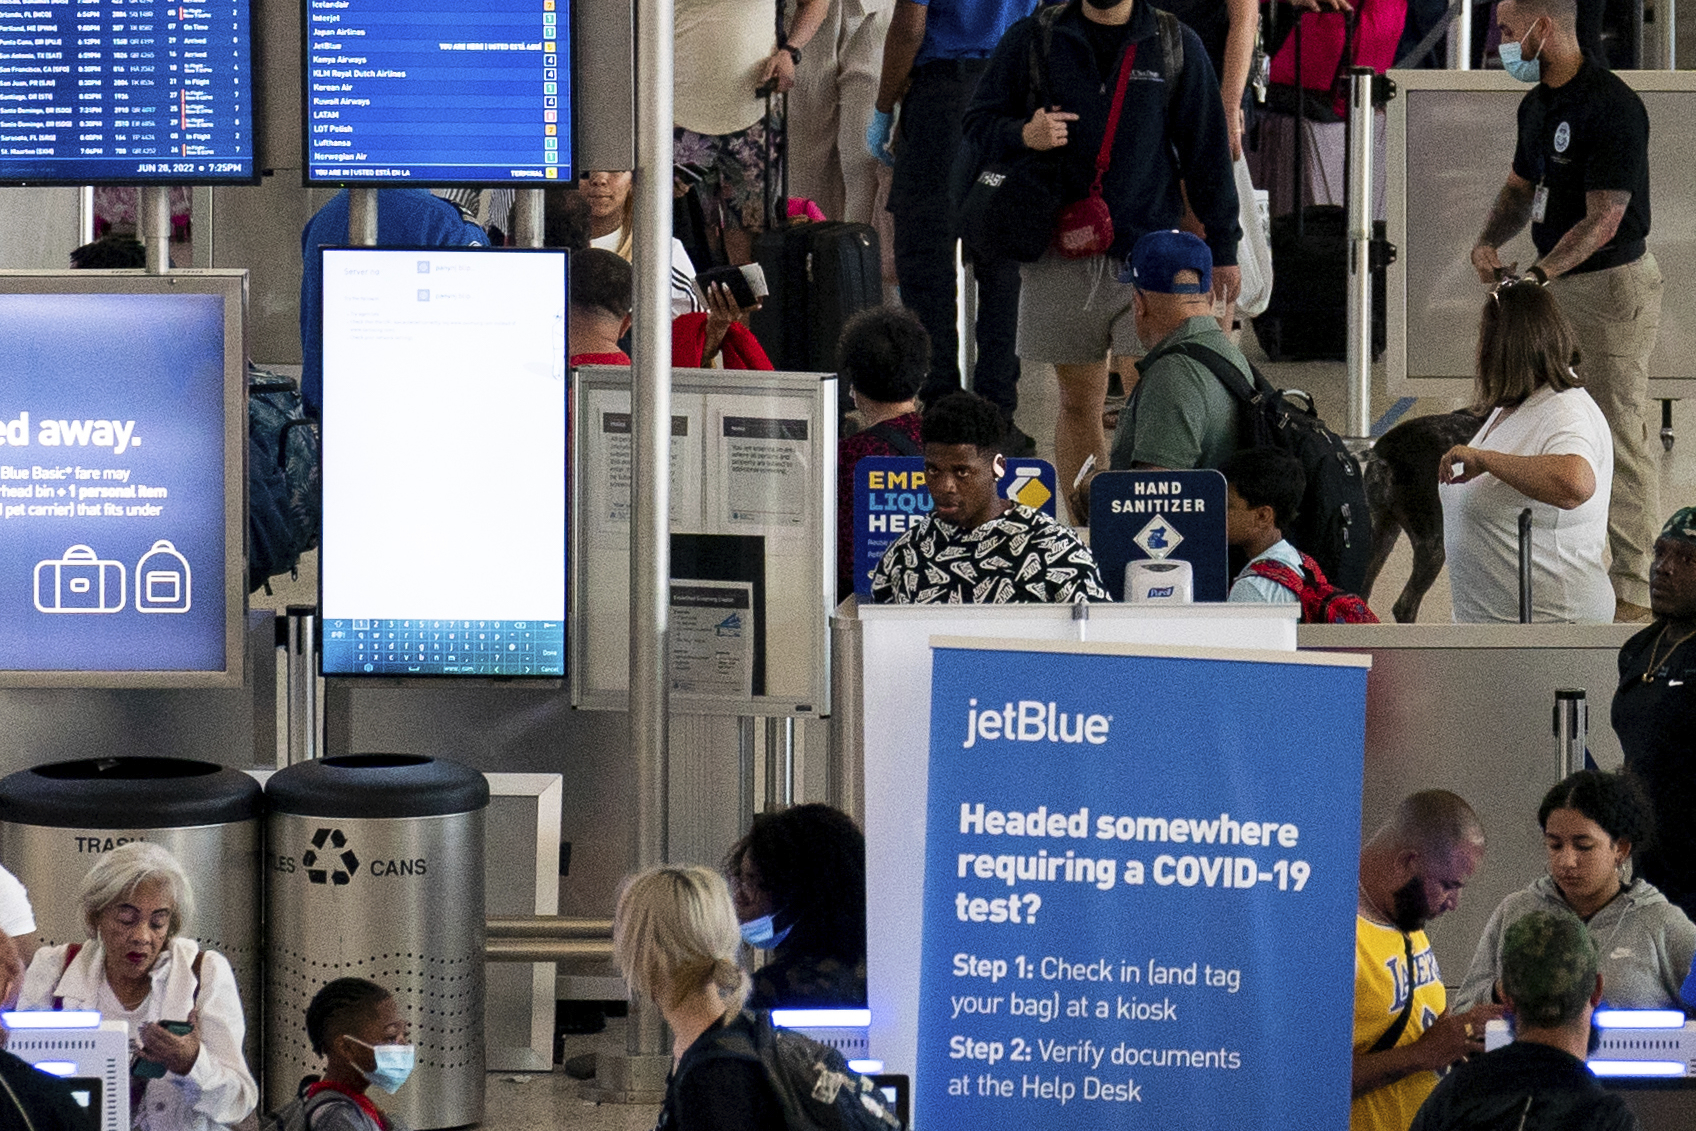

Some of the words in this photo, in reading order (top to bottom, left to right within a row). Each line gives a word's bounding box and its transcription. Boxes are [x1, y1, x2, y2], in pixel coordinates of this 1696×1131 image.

[313, 15, 340, 23] Interjet
[337, 56, 367, 64] Airways
[332, 70, 352, 78] Royal
[354, 69, 375, 77] Dutch
[340, 98, 370, 106] Airways
[315, 153, 354, 161] Norwegian
[137, 164, 156, 172] JUN
[174, 164, 194, 172] 2022
[209, 163, 241, 171] 7:25PM
[38, 419, 141, 454] away.
[75, 466, 101, 479] fare
[103, 469, 130, 483] may
[869, 472, 926, 489] EMP
[0, 484, 32, 497] head
[35, 484, 54, 497] bin
[79, 485, 136, 501] personal
[138, 485, 168, 498] item
[1135, 482, 1181, 494] HAND
[5, 503, 26, 519] pet
[28, 502, 74, 517] carrier)
[77, 503, 101, 516] that
[104, 503, 124, 516] fits
[126, 503, 163, 516] under
[869, 493, 934, 513] LIQU
[1112, 499, 1204, 513] SANITIZER
[869, 515, 924, 532] HE
[963, 699, 1112, 748] jetBlue
[960, 803, 1088, 838] Headed
[1096, 814, 1298, 847] somewhere
[75, 837, 144, 853] TRA
[370, 859, 427, 876] CANS
[958, 850, 1116, 890] requiring
[1124, 861, 1144, 884] a
[1154, 855, 1310, 891] COVID-19
[956, 893, 1041, 923] test?
[953, 954, 1007, 982] Step
[1016, 956, 1033, 978] 1:
[1041, 957, 1112, 981] Check
[1121, 960, 1140, 982] in
[1149, 959, 1197, 985] (and
[1205, 965, 1240, 993] tag
[1386, 947, 1442, 1013] LAER
[951, 996, 1004, 1018] your
[1011, 992, 1059, 1022] bag)
[1067, 997, 1088, 1017] at
[1096, 1001, 1109, 1018] a
[1117, 996, 1176, 1020] kiosk
[950, 1036, 1003, 1064] Step
[1010, 1038, 1031, 1061] 2:
[1038, 1039, 1104, 1069] Verify
[1111, 1042, 1240, 1068] documents
[948, 1075, 970, 1095] at
[977, 1074, 1014, 1097] the
[1022, 1075, 1075, 1105] Help
[1084, 1077, 1141, 1101] Desk
